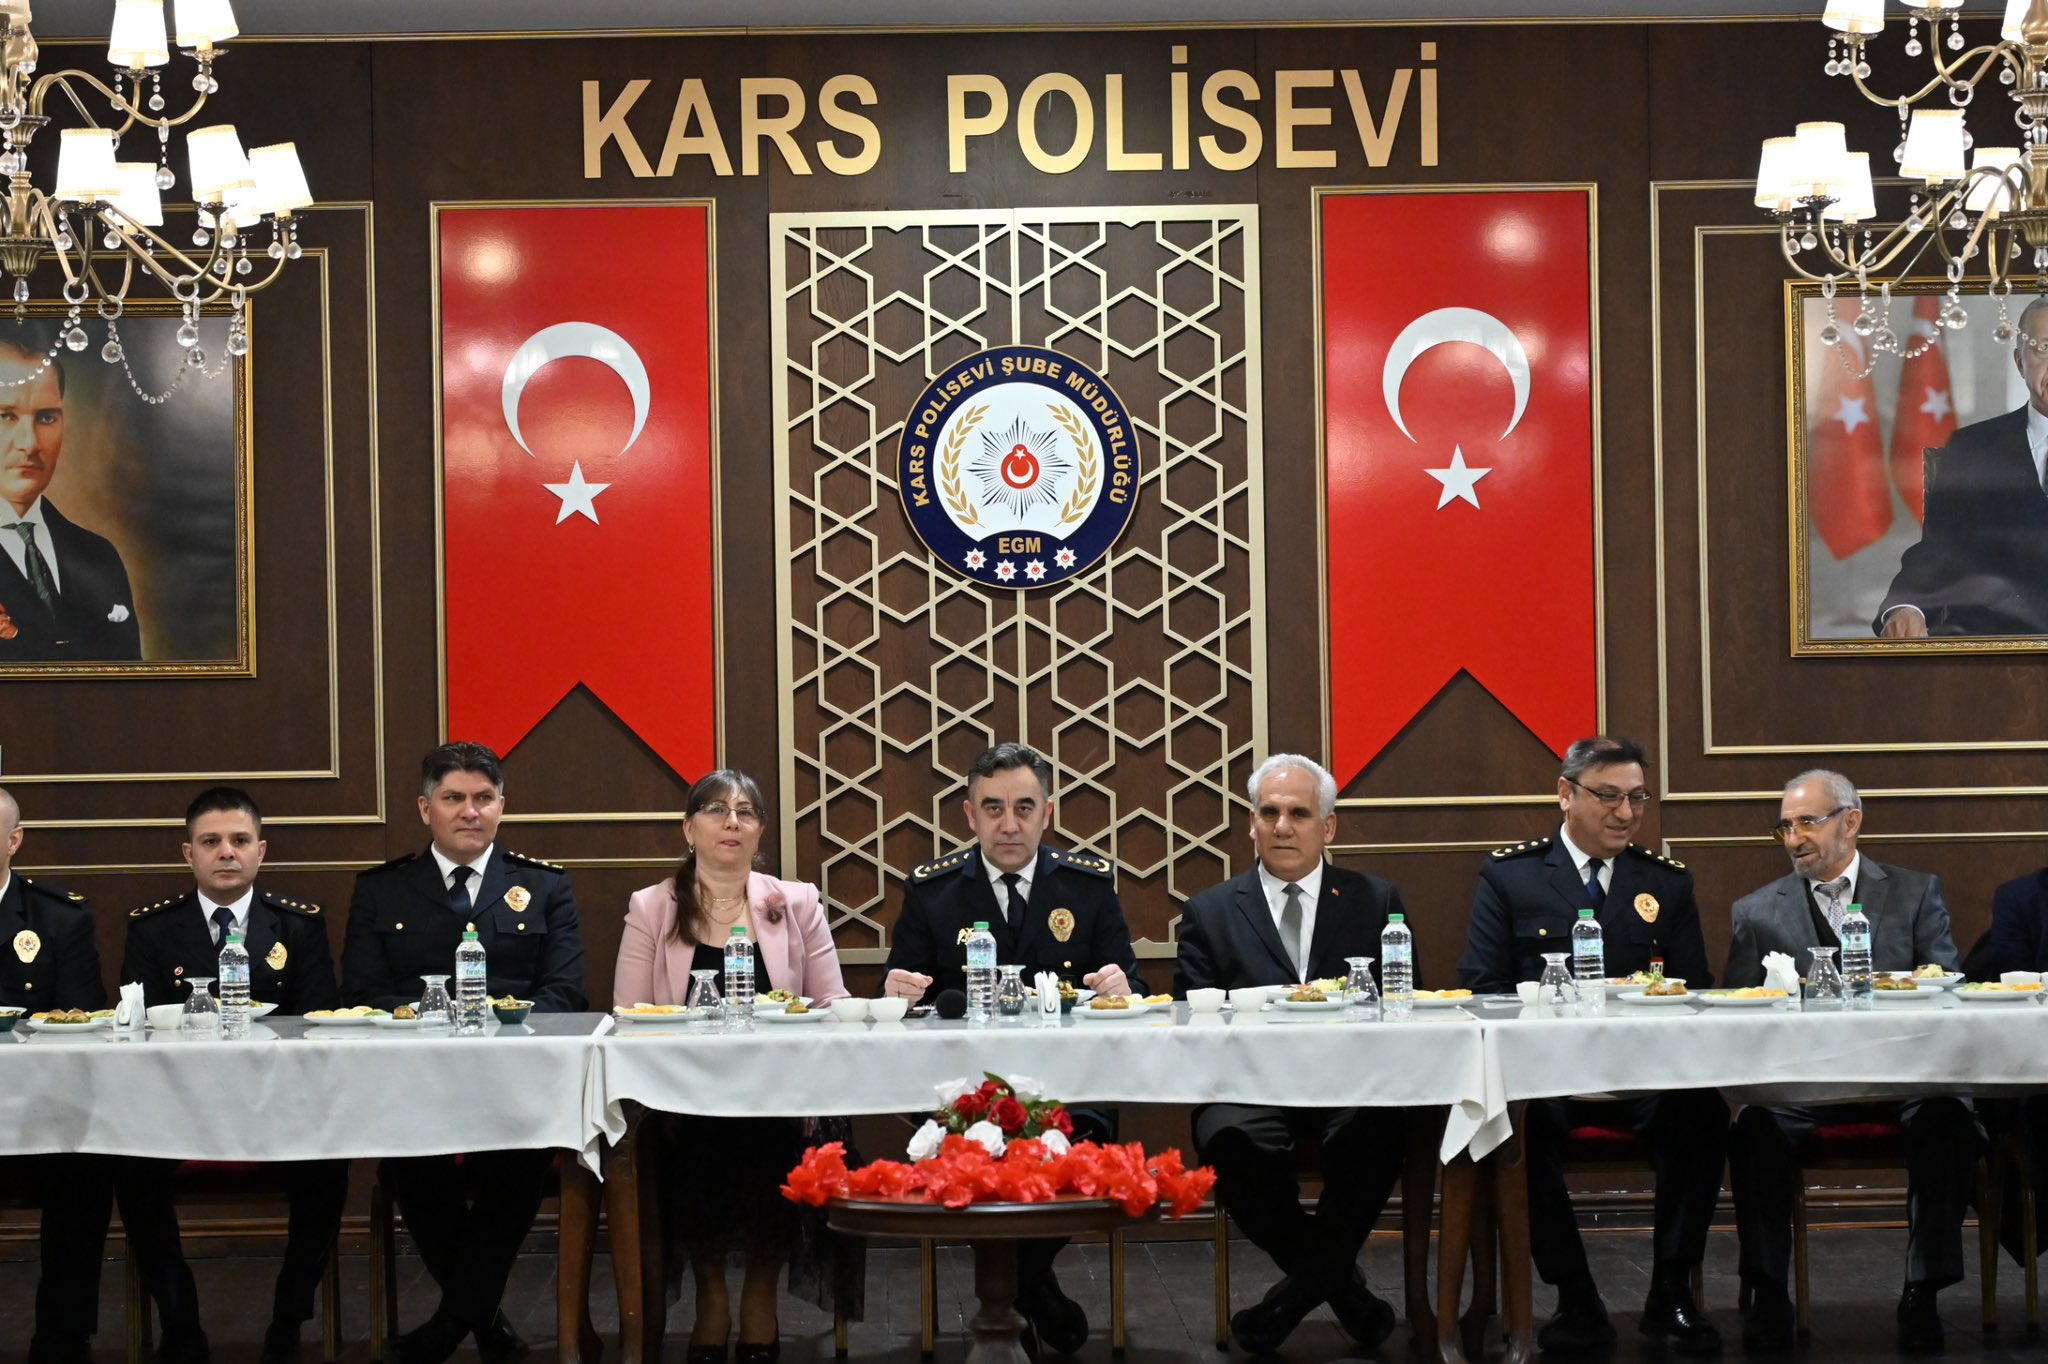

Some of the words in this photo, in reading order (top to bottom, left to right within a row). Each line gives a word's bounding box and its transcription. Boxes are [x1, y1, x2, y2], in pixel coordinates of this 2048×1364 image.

[582, 74, 882, 180] KARS
[947, 42, 1440, 175] POLİSEVİ
[915, 357, 995, 439] POLİSEVİ
[1001, 356, 1063, 380] ŞUBE
[1065, 371, 1132, 504] MÜDÜRLÜĞÜ
[910, 445, 930, 507] KARS
[998, 537, 1042, 554] EGM
